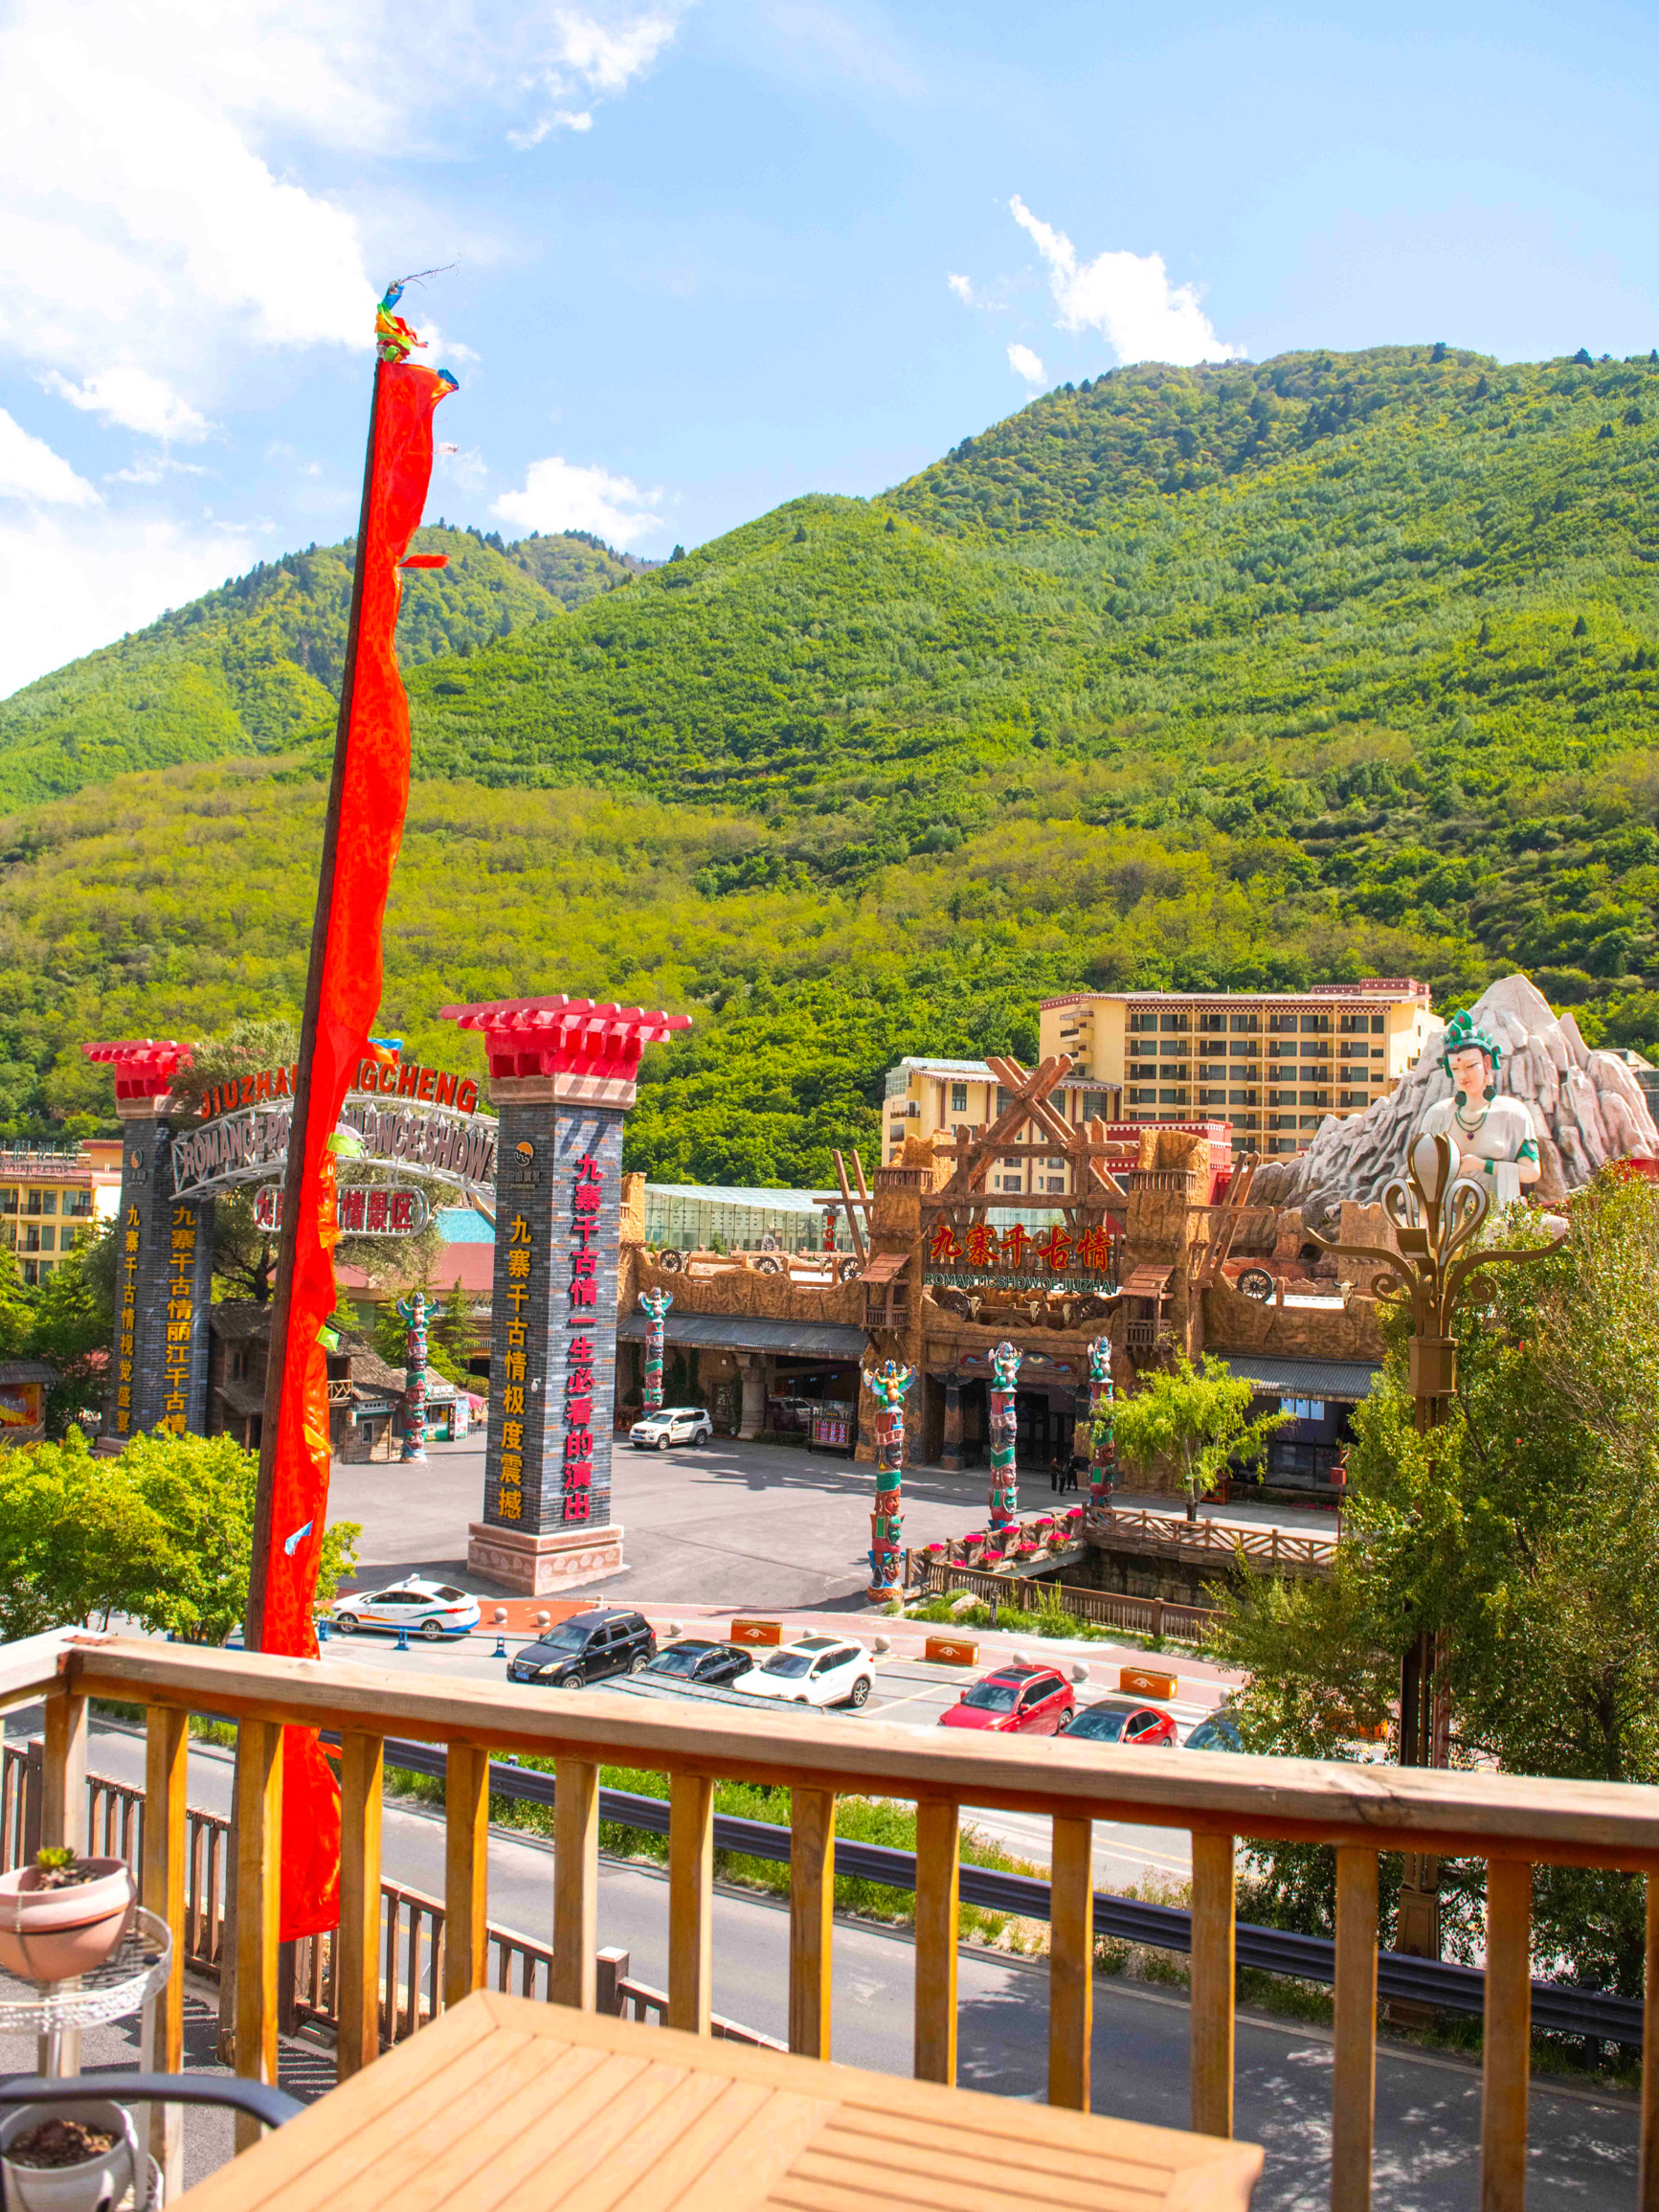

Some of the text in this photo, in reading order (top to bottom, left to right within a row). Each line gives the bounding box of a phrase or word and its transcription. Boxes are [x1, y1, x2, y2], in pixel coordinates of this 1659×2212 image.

[117, 1204, 140, 1433] 九寨千古情视觉盛宴
[162, 1206, 197, 1434] 九寨千古情丽江千古情
[564, 1153, 603, 1521] 九寨千古情一生必看的演出
[930, 1223, 1111, 1273] 九寨千古情
[498, 1214, 532, 1521] 九寨千古情极度震撼
